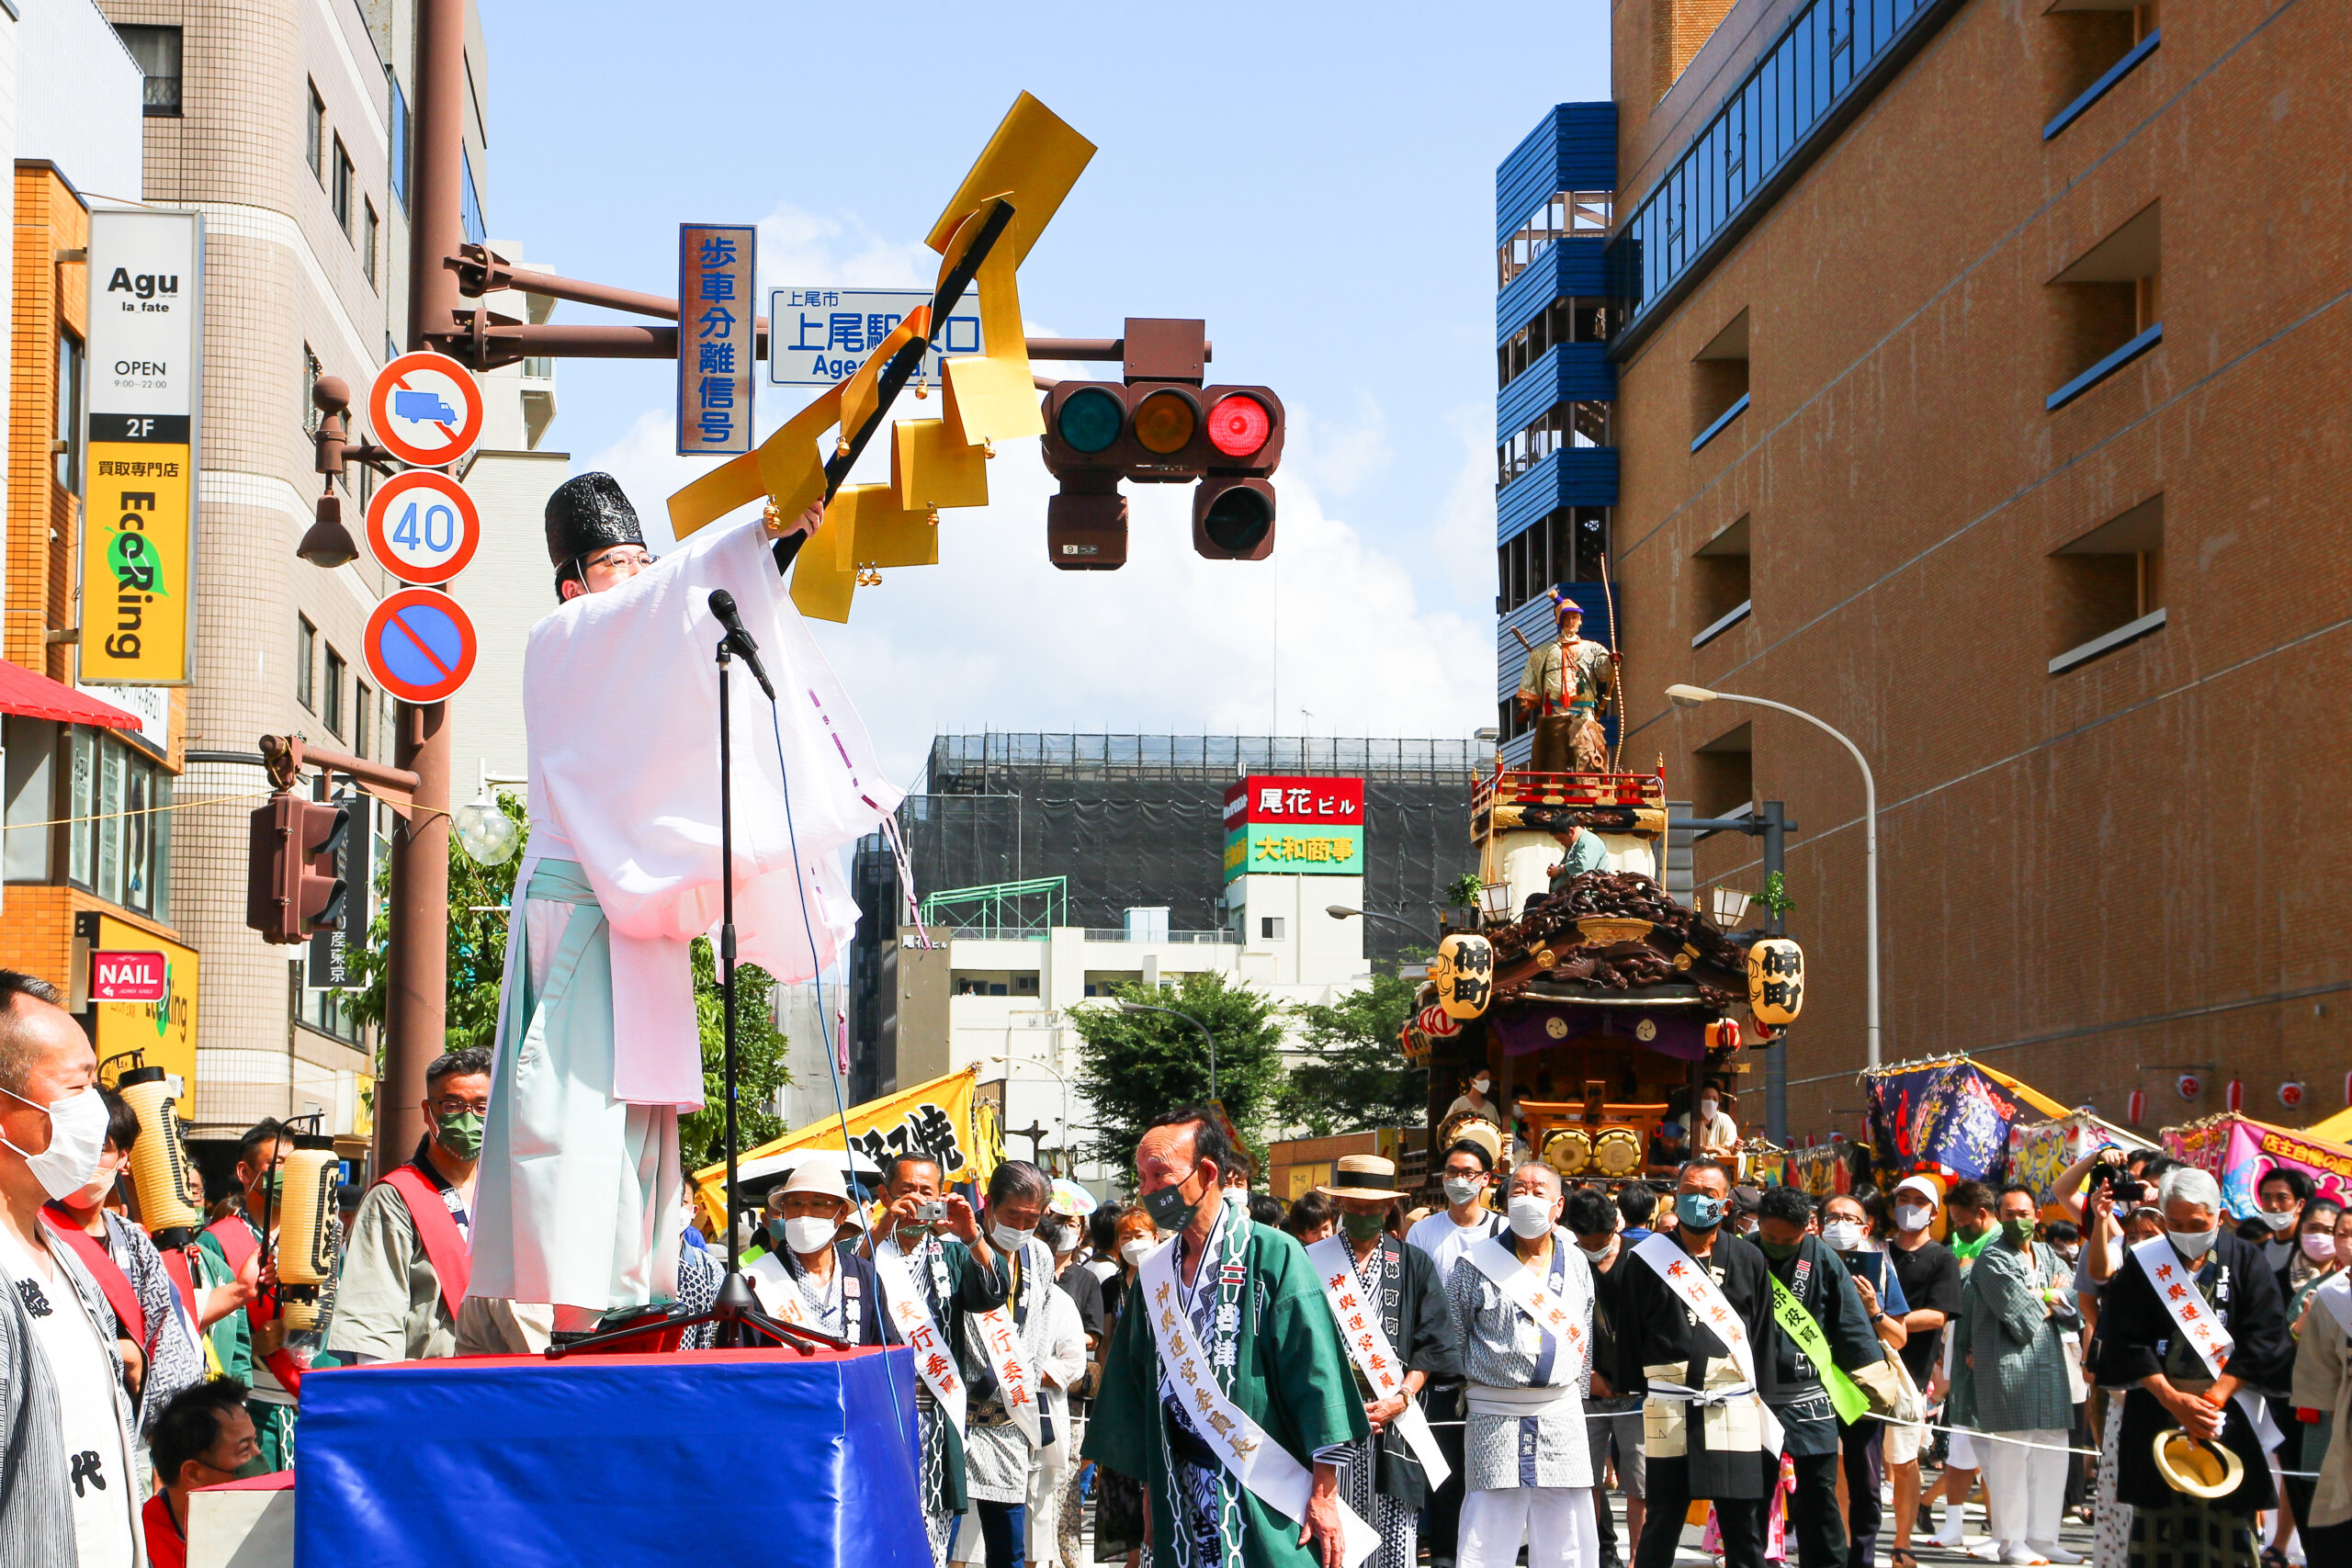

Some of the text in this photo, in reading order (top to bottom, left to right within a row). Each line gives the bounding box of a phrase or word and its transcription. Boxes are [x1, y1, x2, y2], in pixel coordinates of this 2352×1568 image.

[107, 267, 178, 299] Agu
[786, 290, 839, 308] 上尾市
[697, 236, 737, 443] 歩車分離信号
[787, 312, 979, 353] 上尾駅口
[115, 361, 166, 376] OPEN
[126, 419, 154, 437] 2F
[98, 460, 179, 479] 買取専門店
[393, 502, 454, 552] 40
[105, 491, 156, 660] EcoRing
[1259, 787, 1356, 816] 尾花ビル
[1255, 835, 1355, 863] 大和商事
[99, 964, 158, 985] NAIL
[1453, 941, 1492, 1011] 仲町
[1761, 945, 1802, 1014] 仲町
[896, 1300, 958, 1399] 実行委員
